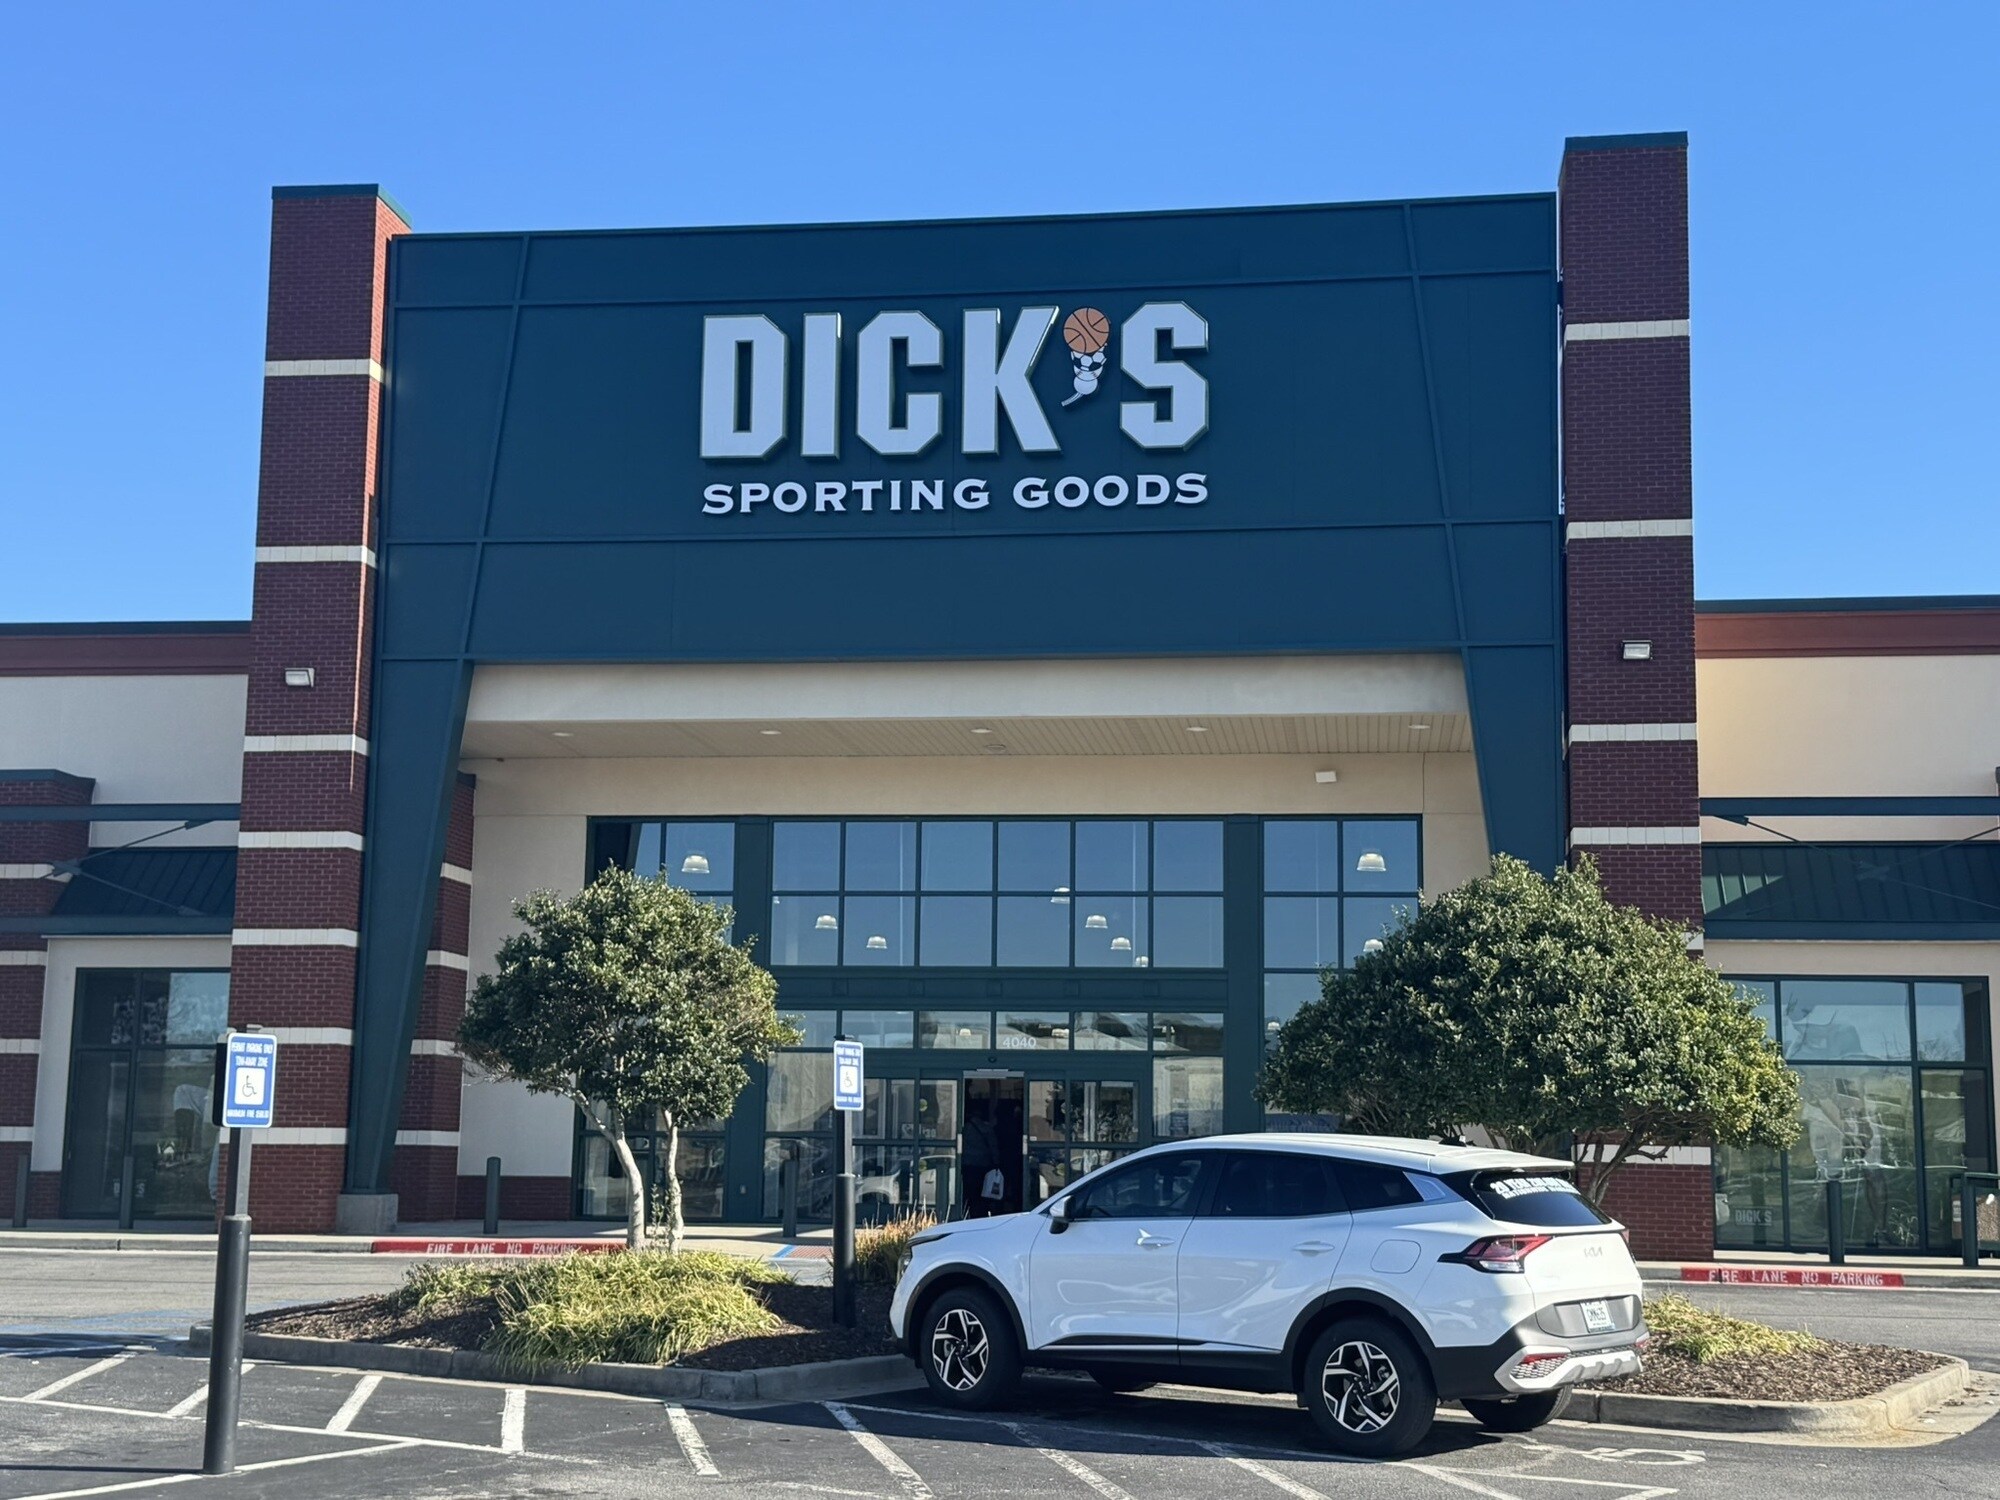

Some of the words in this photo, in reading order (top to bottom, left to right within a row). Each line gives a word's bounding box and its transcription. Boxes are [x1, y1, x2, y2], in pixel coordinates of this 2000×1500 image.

[700, 301, 1209, 460] DICK'S
[702, 479, 990, 514] SPORTING
[1012, 473, 1209, 508] GOODS
[1002, 1036, 1037, 1049] 4040
[1735, 1209, 1772, 1222] DICKS
[427, 1243, 453, 1253] FIRE
[464, 1243, 495, 1253] LANE
[507, 1242, 522, 1253] NO
[1708, 1269, 1739, 1282] FIRE
[1752, 1270, 1788, 1282] LANE
[1801, 1271, 1819, 1283] NO
[1831, 1272, 1883, 1285] PARKING
